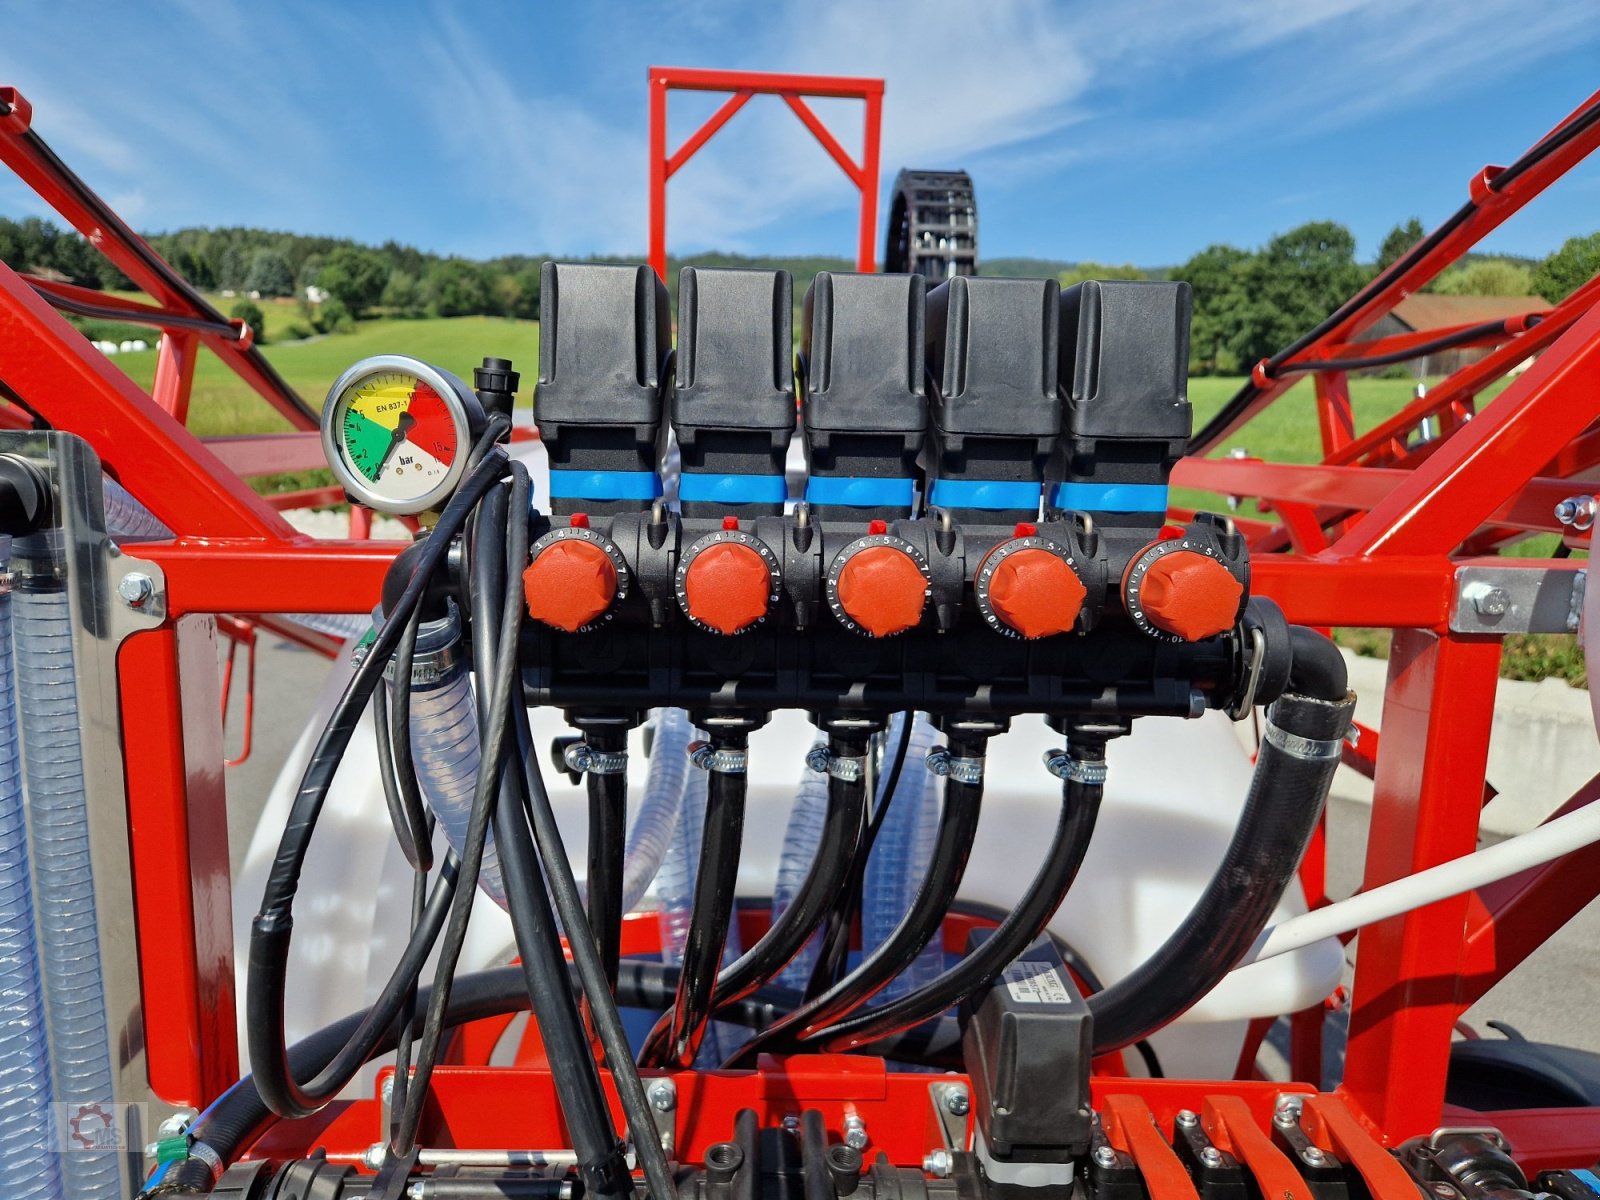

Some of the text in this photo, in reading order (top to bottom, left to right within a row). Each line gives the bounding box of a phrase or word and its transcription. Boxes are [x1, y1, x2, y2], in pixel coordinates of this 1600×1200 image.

[376, 400, 408, 413] EN 837-1
[358, 410, 365, 419] 5
[356, 424, 362, 433] 4
[433, 442, 443, 453] 15
[362, 448, 369, 458] 2
[399, 455, 414, 466] bar
[558, 530, 564, 538] 4
[584, 531, 591, 539] 5
[605, 545, 613, 553] 6
[838, 555, 846, 563] 3
[906, 545, 914, 553] 6
[1048, 542, 1054, 550] 5
[1066, 557, 1074, 565] 6
[1157, 546, 1165, 554] 3
[1205, 547, 1212, 555] 5
[678, 566, 686, 574] 2
[692, 545, 700, 553] 3
[760, 548, 769, 556] 6
[1138, 564, 1147, 572] 2
[1148, 628, 1159, 637] 11
